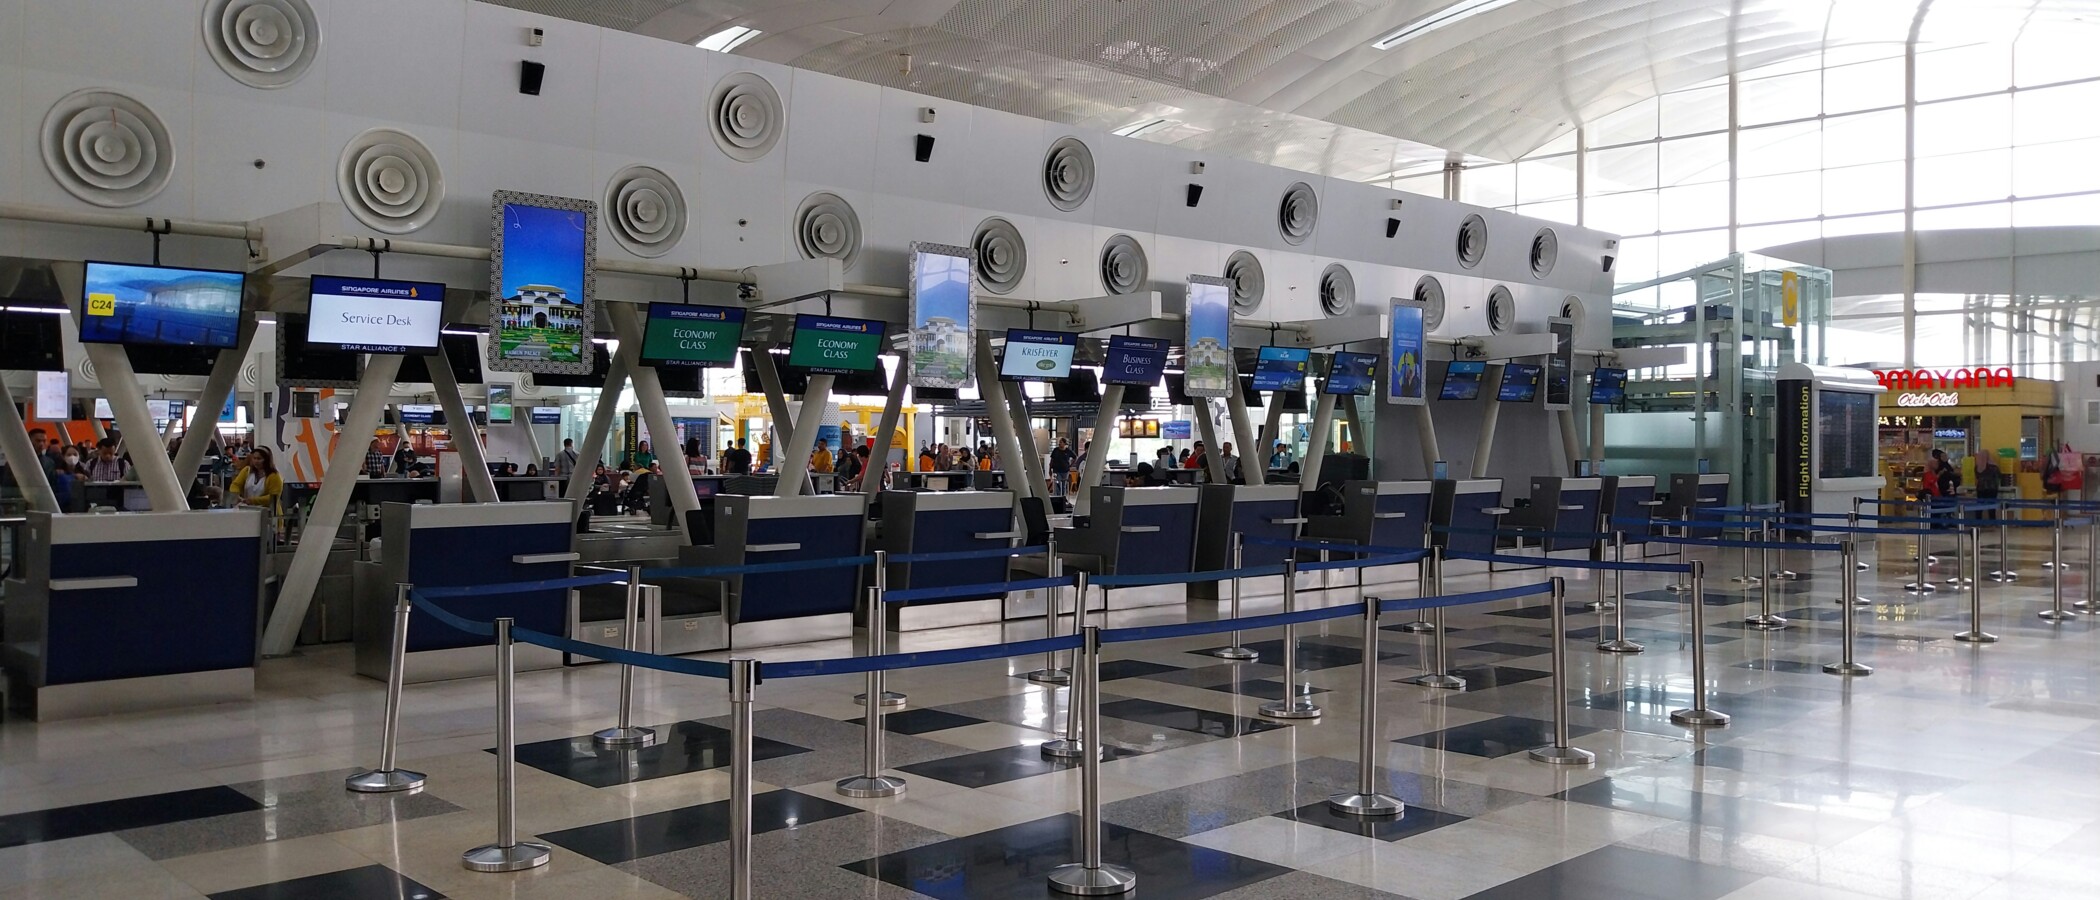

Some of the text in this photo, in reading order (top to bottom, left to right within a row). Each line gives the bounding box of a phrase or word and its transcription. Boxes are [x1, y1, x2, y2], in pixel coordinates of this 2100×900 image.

[91, 300, 112, 310] C24
[341, 312, 412, 326] Service Desk
[673, 328, 718, 340] ECONOMY
[680, 340, 706, 350] CLASS
[818, 338, 858, 350] ECONOMY
[824, 348, 848, 359] CLASS
[1122, 354, 1152, 364] BUSINESS
[1126, 364, 1144, 374] CLASS
[1799, 386, 1810, 498] Flight Information
